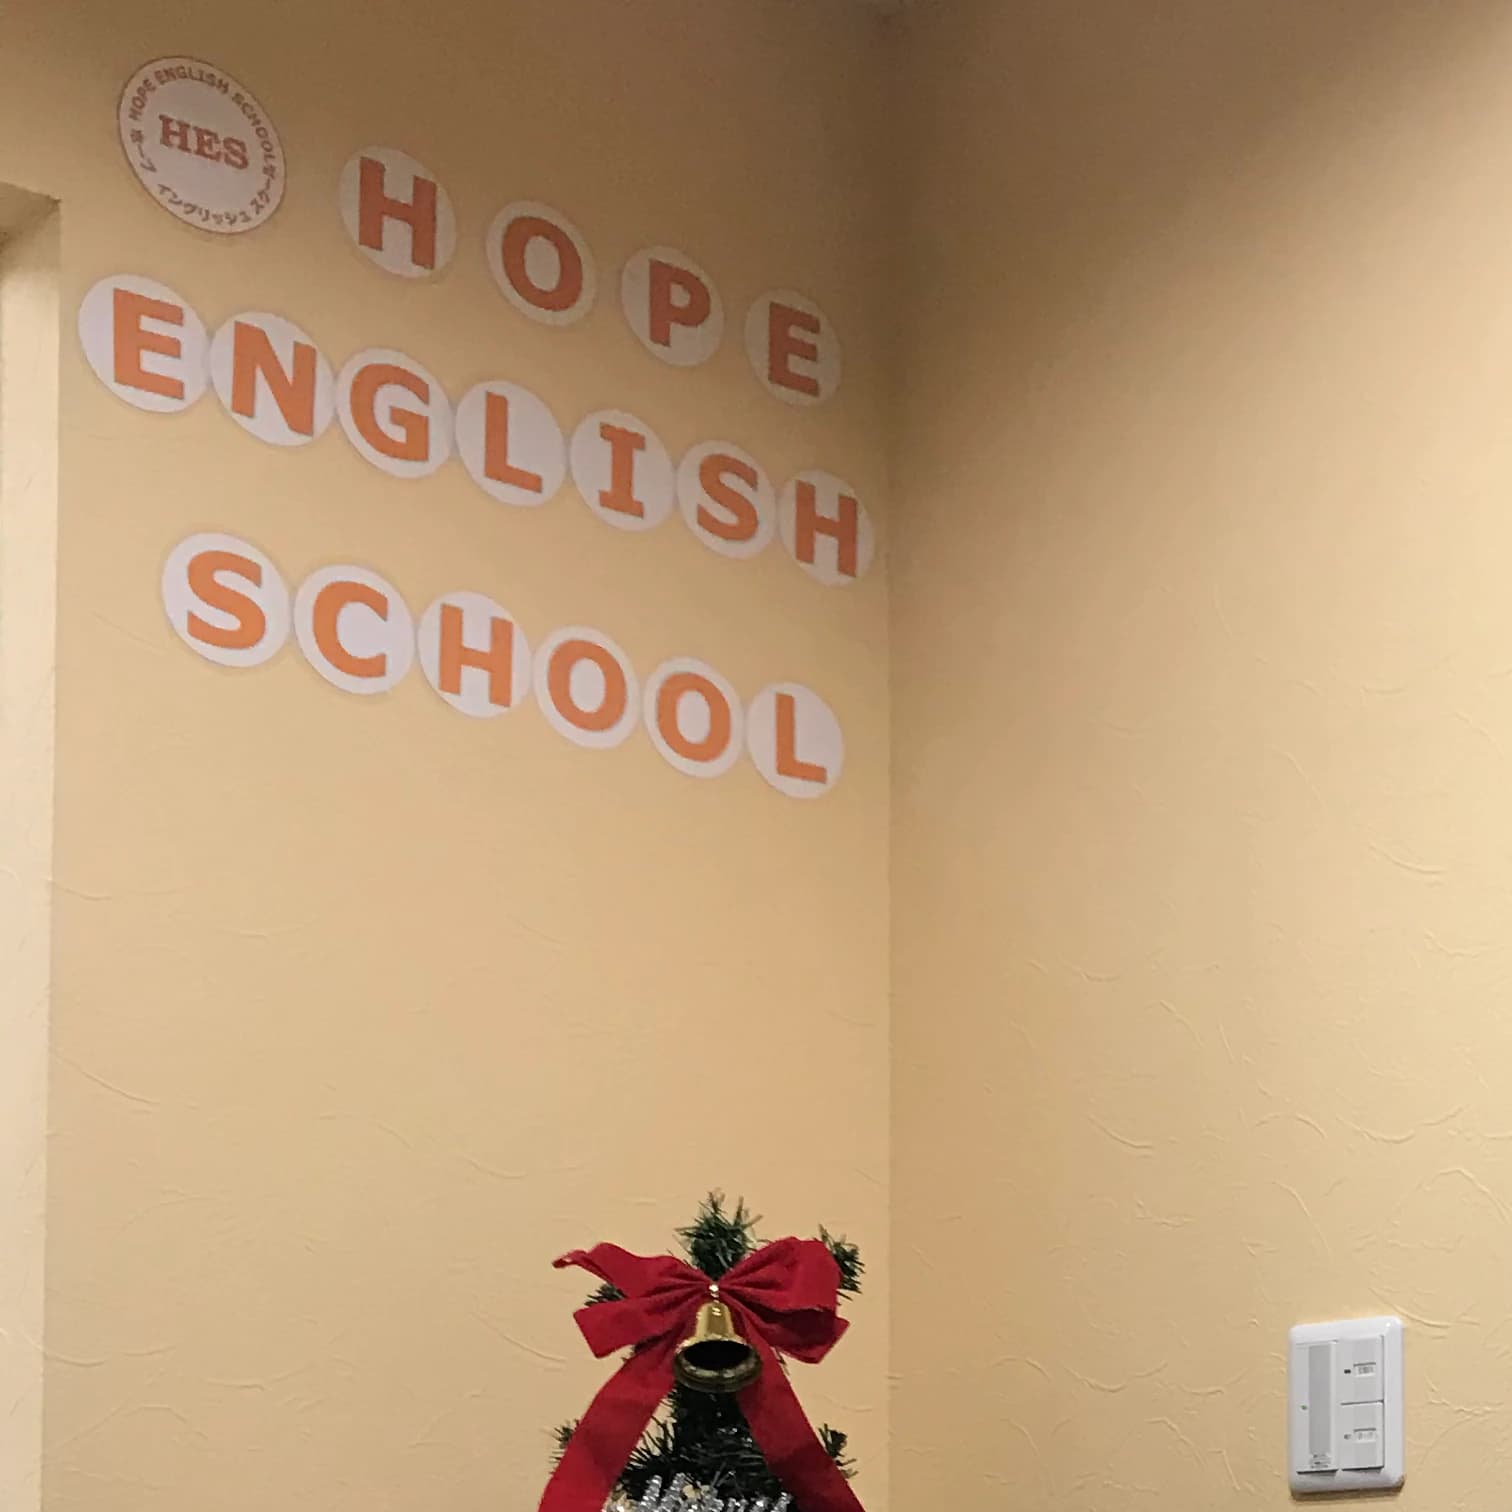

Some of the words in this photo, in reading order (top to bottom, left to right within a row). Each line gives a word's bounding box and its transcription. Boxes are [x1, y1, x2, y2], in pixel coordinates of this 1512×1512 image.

[128, 79, 156, 121] HOPE
[154, 66, 229, 94] ENGLISH
[232, 92, 276, 163] SCHOOL
[159, 114, 249, 170] HES
[356, 156, 822, 397] HOPE
[111, 288, 860, 578] ENGLISH
[185, 550, 829, 784] SCHOOL
